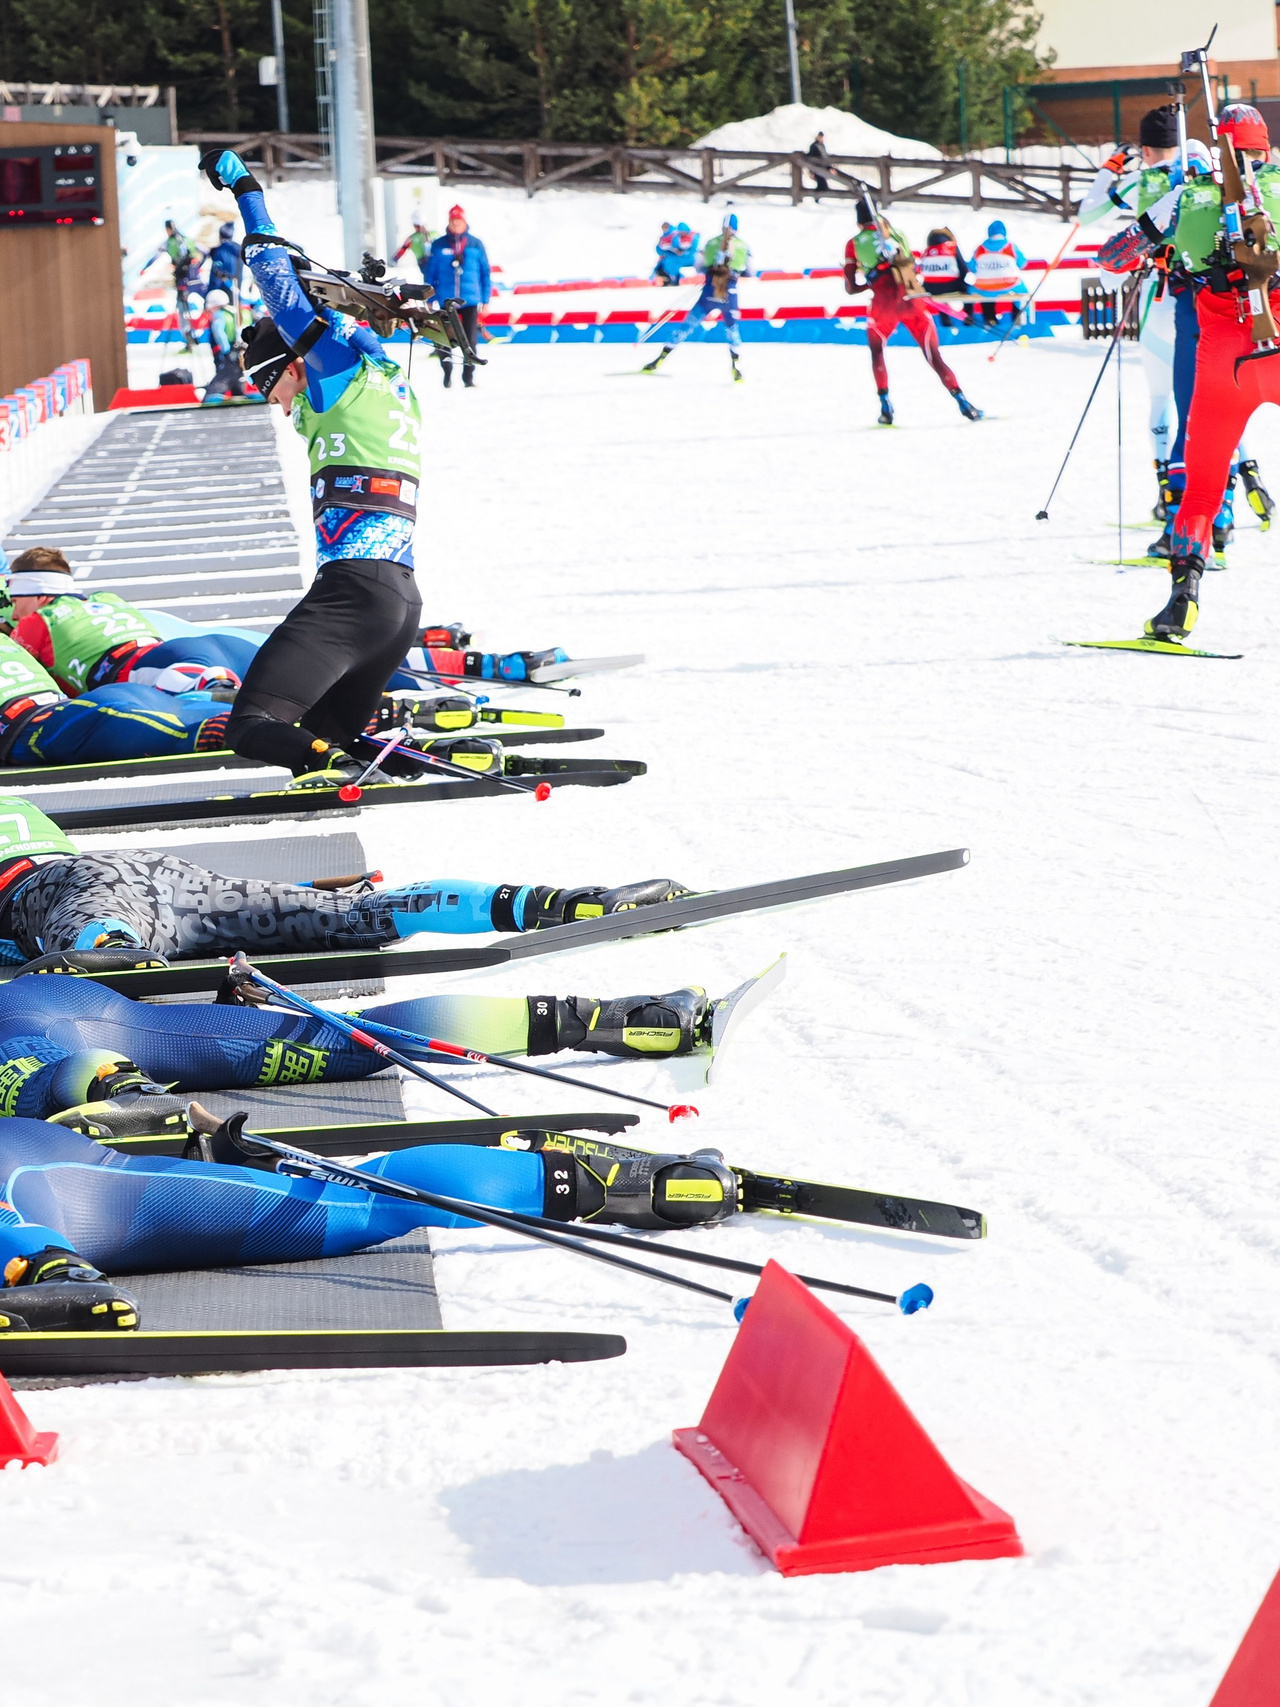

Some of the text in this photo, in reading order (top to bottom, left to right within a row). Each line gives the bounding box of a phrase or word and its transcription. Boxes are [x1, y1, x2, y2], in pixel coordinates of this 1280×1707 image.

[261, 369, 278, 393] MOAX
[315, 433, 346, 461] 23
[91, 612, 147, 637] 22
[499, 888, 511, 899] 27
[537, 1001, 548, 1016] 30
[554, 1170, 570, 1195] 32
